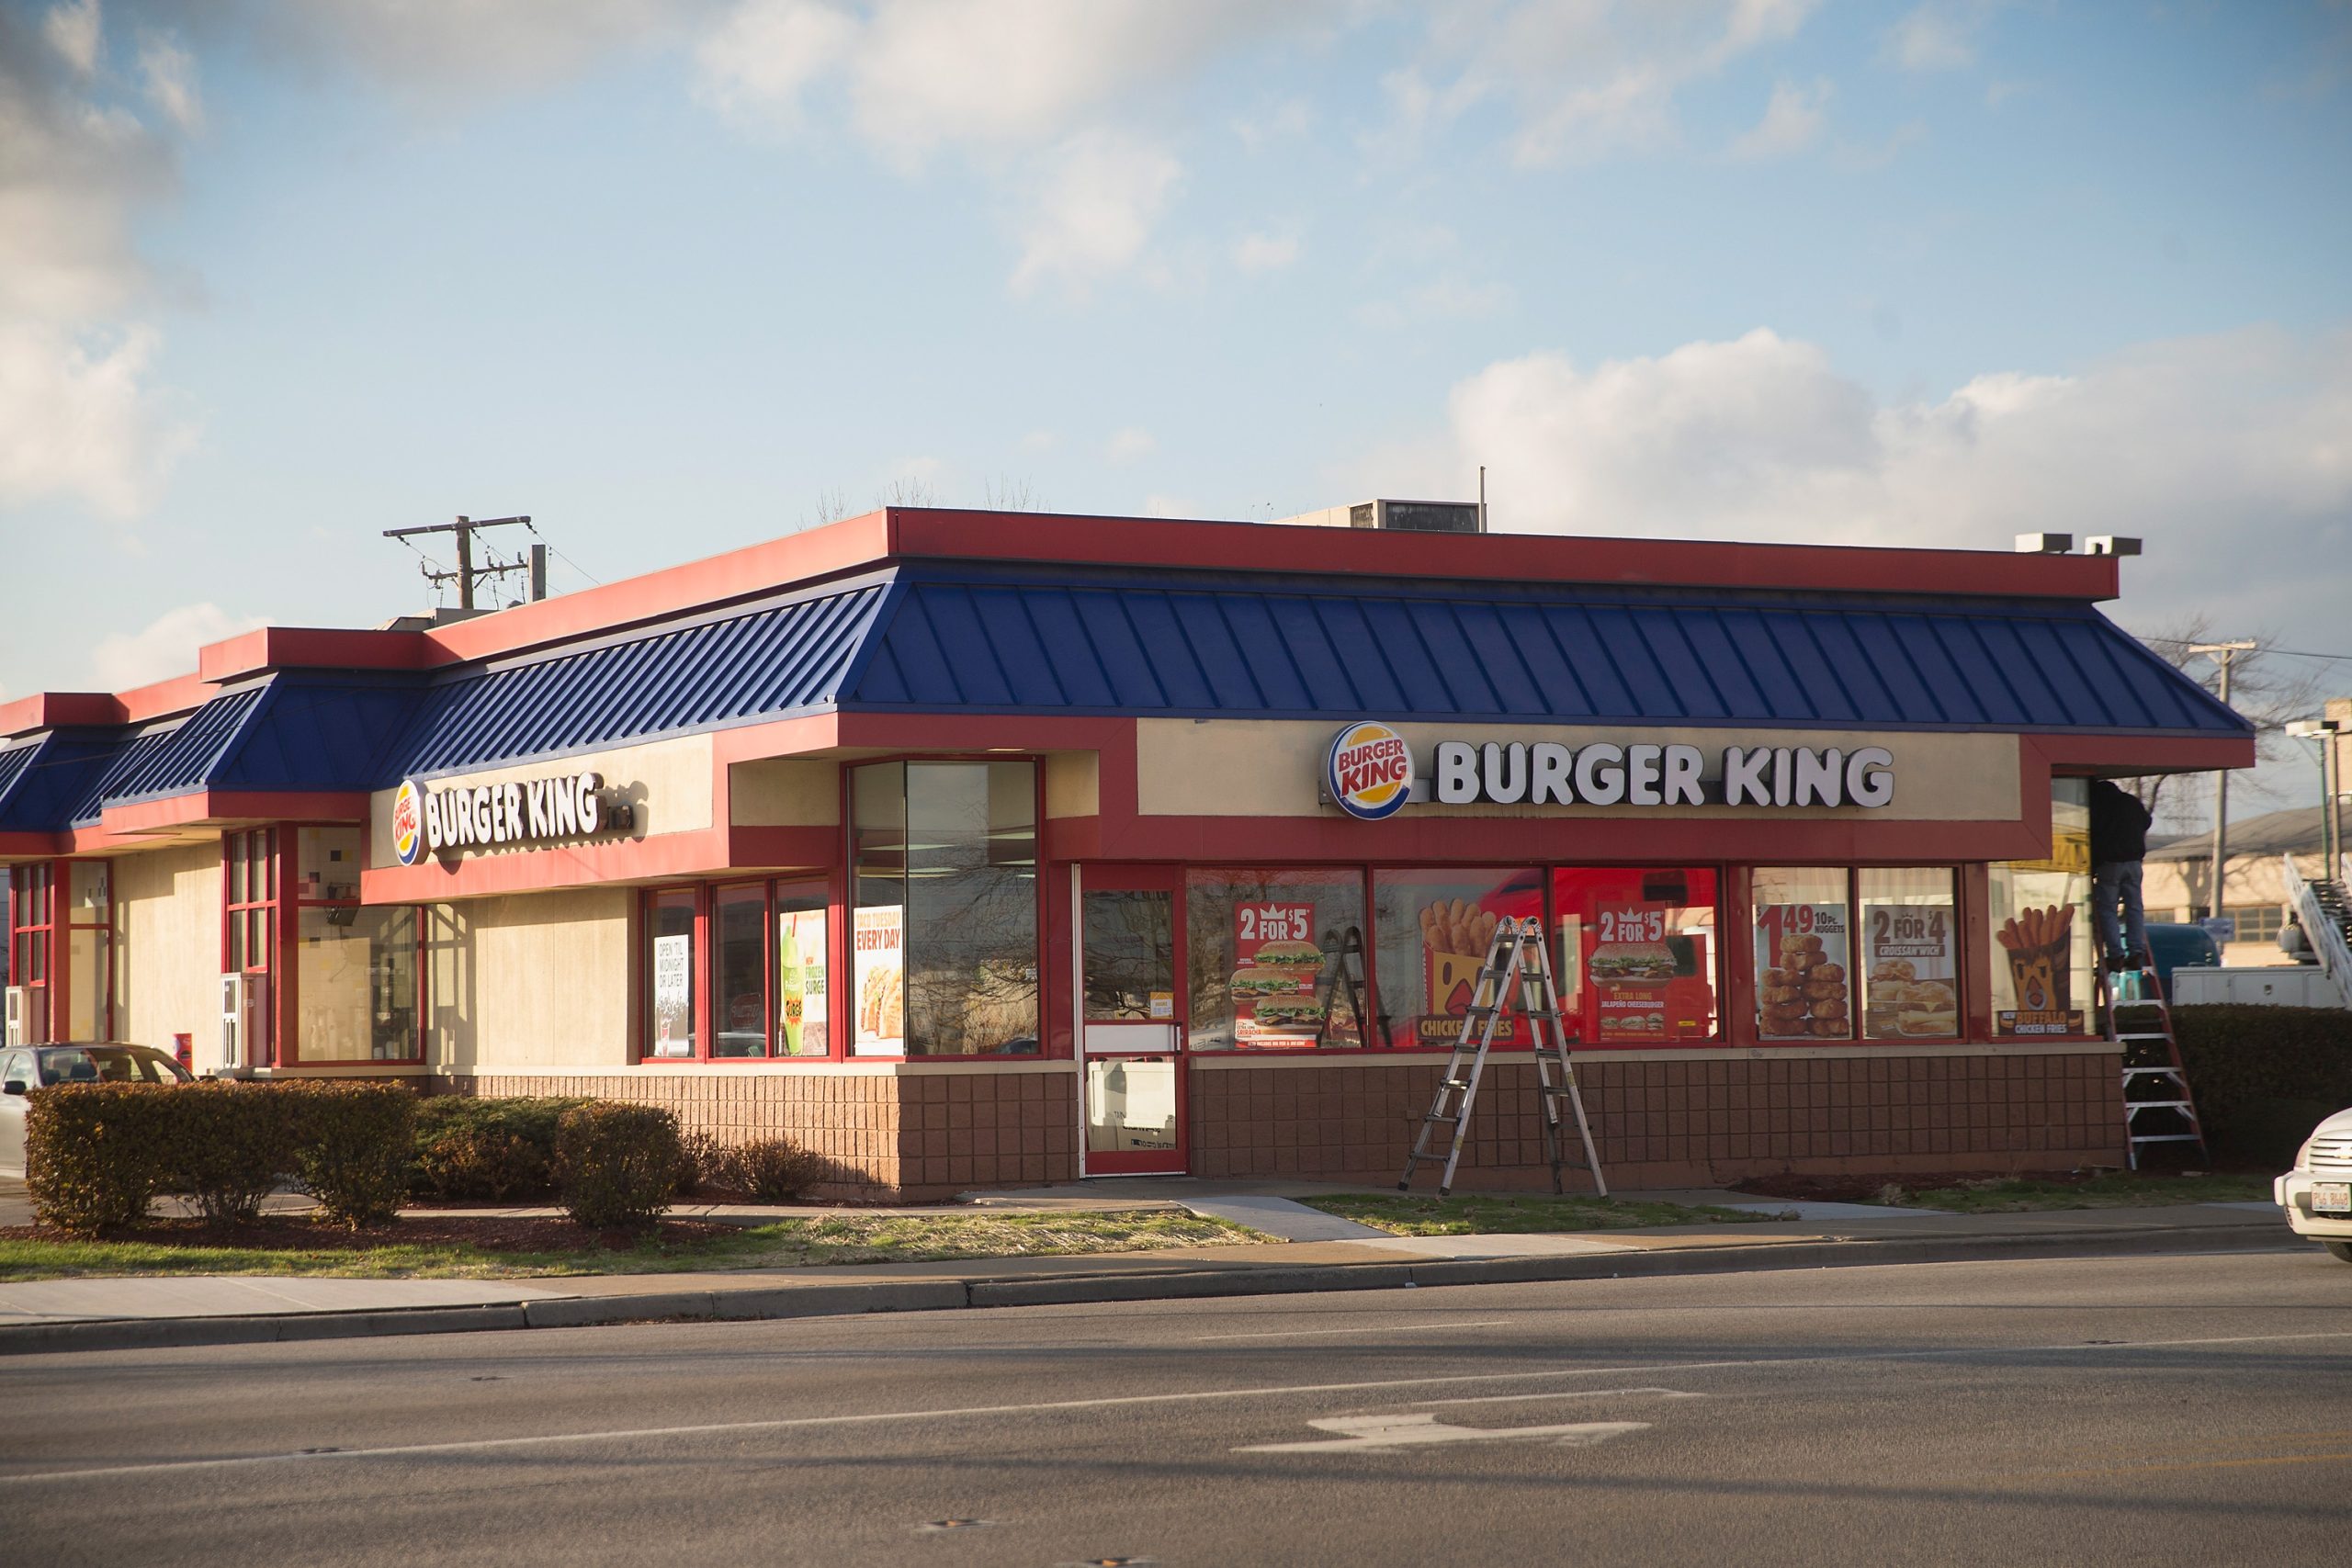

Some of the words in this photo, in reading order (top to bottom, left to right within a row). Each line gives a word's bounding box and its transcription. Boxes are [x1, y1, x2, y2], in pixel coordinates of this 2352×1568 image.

[1339, 739, 1404, 772] BURGER
[1341, 756, 1407, 796] KING
[1435, 741, 1705, 807] BURGER
[1724, 745, 1895, 808] KING
[424, 782, 525, 850] BURGER
[526, 772, 598, 839] KING
[856, 913, 871, 928] TACO
[873, 910, 900, 927] TUESDAY
[1240, 908, 1255, 940] 2
[1260, 920, 1288, 940] FOR
[1600, 911, 1614, 942] 2
[1618, 923, 1645, 942] FOR
[1872, 910, 1891, 944] 2
[1894, 918, 1925, 939] FOR
[1815, 925, 1845, 933] NUGGETS
[856, 929, 883, 951] EVERY
[884, 928, 900, 950] DAY
[660, 942, 673, 956] OPEN
[659, 957, 684, 972] MIDNIGHT
[805, 966, 825, 979] FROZEN
[667, 974, 684, 987] LATER
[805, 979, 825, 995] SURGE
[1613, 992, 1634, 1000] EXTRA
[1635, 992, 1652, 1000] LONG
[786, 999, 802, 1017] SURGE
[2016, 1011, 2067, 1024] BUFFALO
[1477, 1020, 1513, 1037] FIES
[2015, 1024, 2045, 1034] CHICKEN
[2046, 1023, 2068, 1033] FRIES
